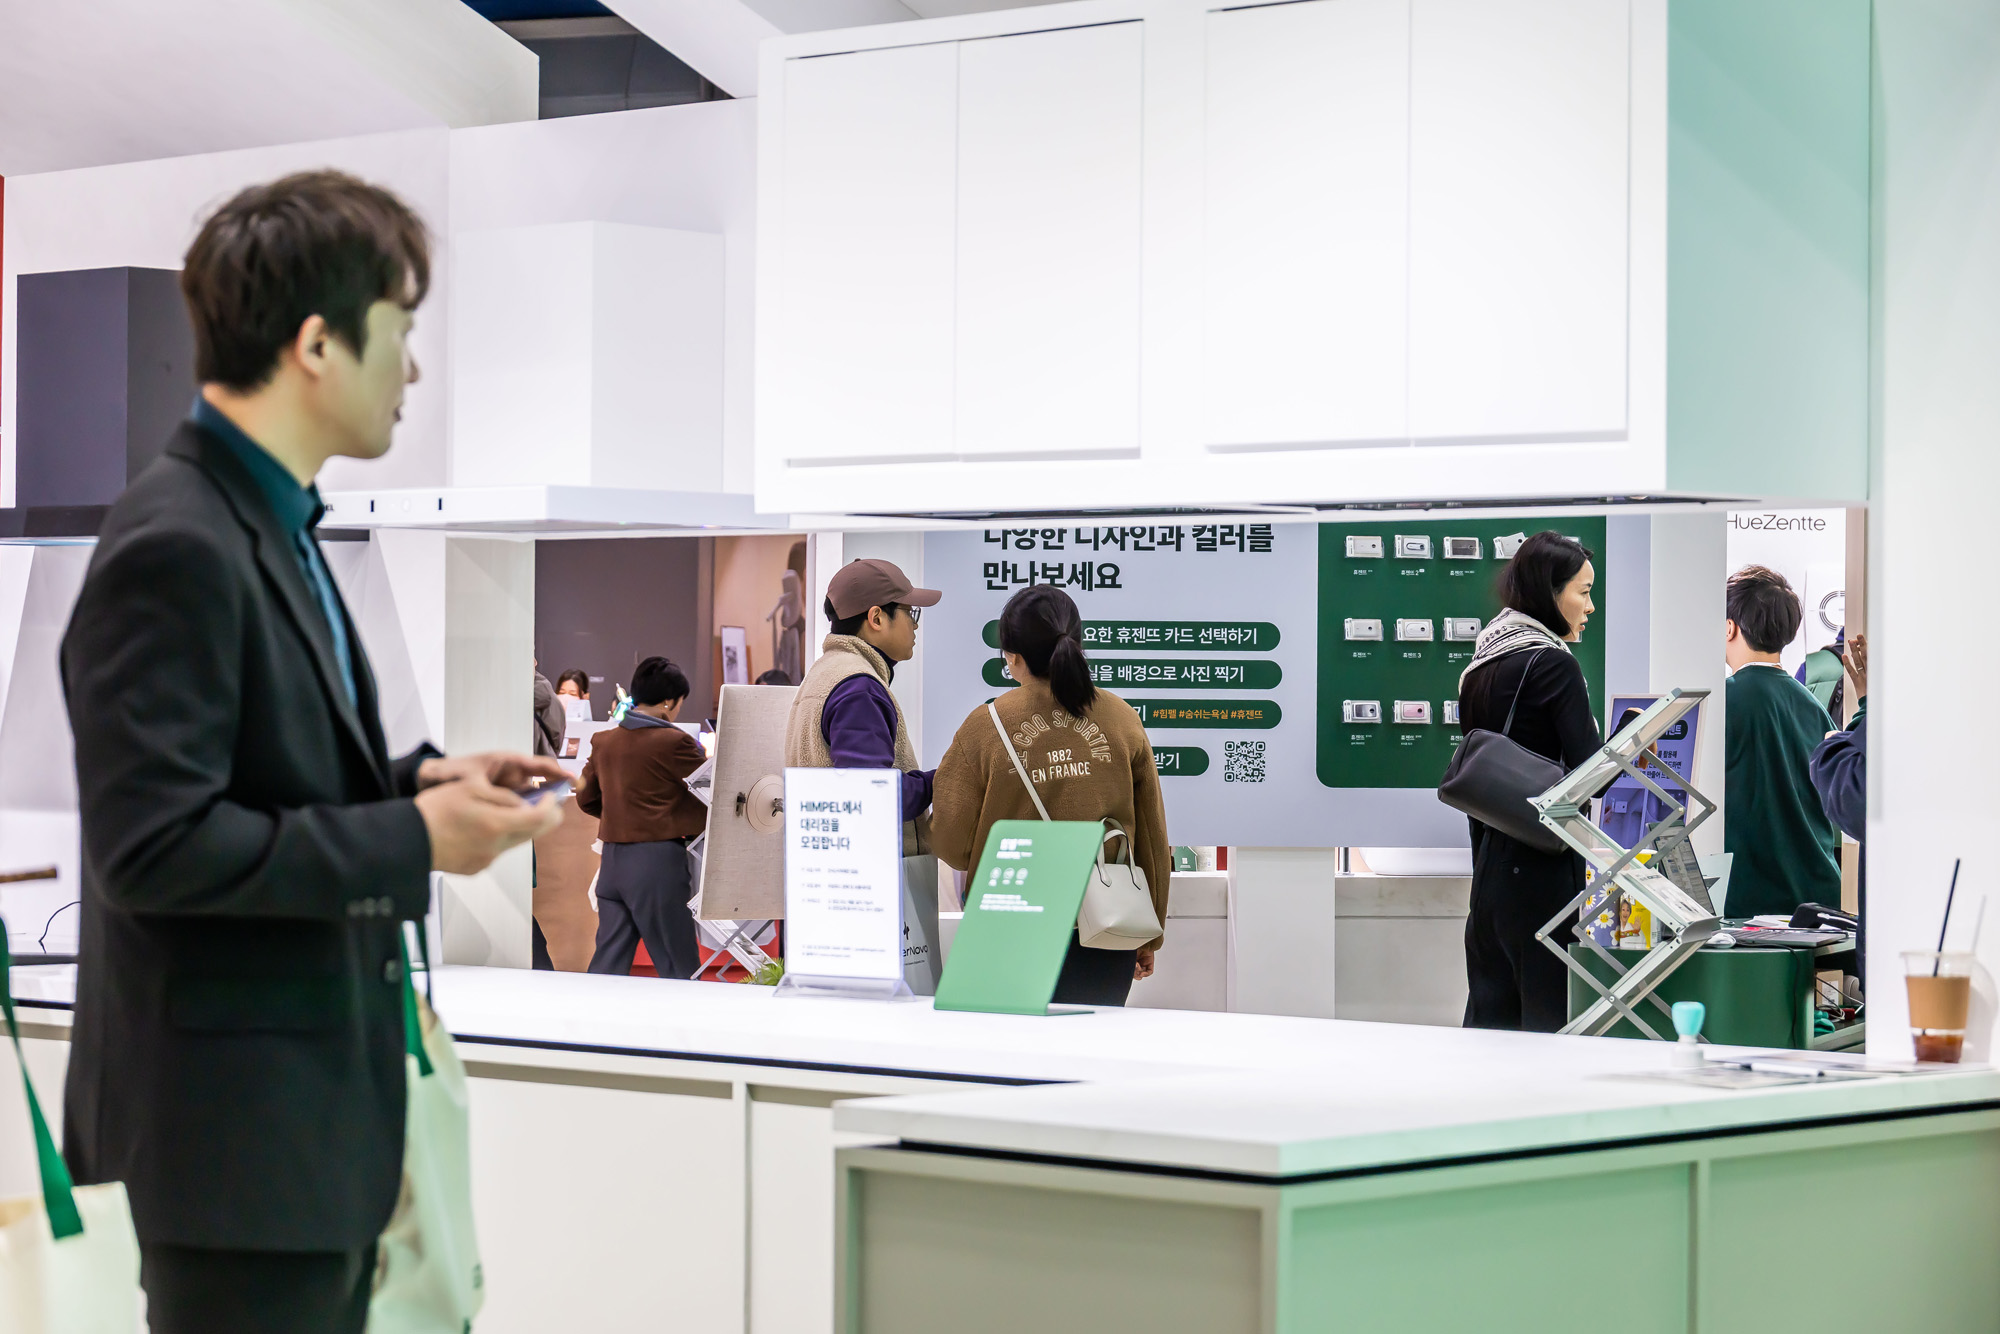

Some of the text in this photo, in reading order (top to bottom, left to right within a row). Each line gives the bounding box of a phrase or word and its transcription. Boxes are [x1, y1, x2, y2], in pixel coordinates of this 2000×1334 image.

[1727, 514, 1826, 531] HueZentte
[1075, 526, 1185, 552] 디자인과
[1191, 524, 1275, 553] 컬러를
[983, 560, 1122, 591] 만나보세요
[1116, 626, 1161, 644] 휴젠뜨
[1165, 627, 1194, 644] 카드
[1198, 627, 1257, 645] 선택하기
[1118, 665, 1177, 682] 배경으로
[1181, 665, 1210, 682] 사진
[1214, 665, 1244, 682] 찍기
[1152, 709, 1177, 719] #힘펠
[1178, 709, 1228, 720] #숨쉬는욕실
[1230, 709, 1263, 720] #휴젠뜨
[1012, 713, 1050, 746] COQ
[1052, 709, 1112, 763] SPORTIF
[1047, 749, 1072, 763] 1882
[1154, 752, 1179, 769] 받기
[1032, 761, 1091, 783] EN FRANCE
[800, 818, 839, 832] 대리점을
[801, 836, 850, 850] 모집합니다
